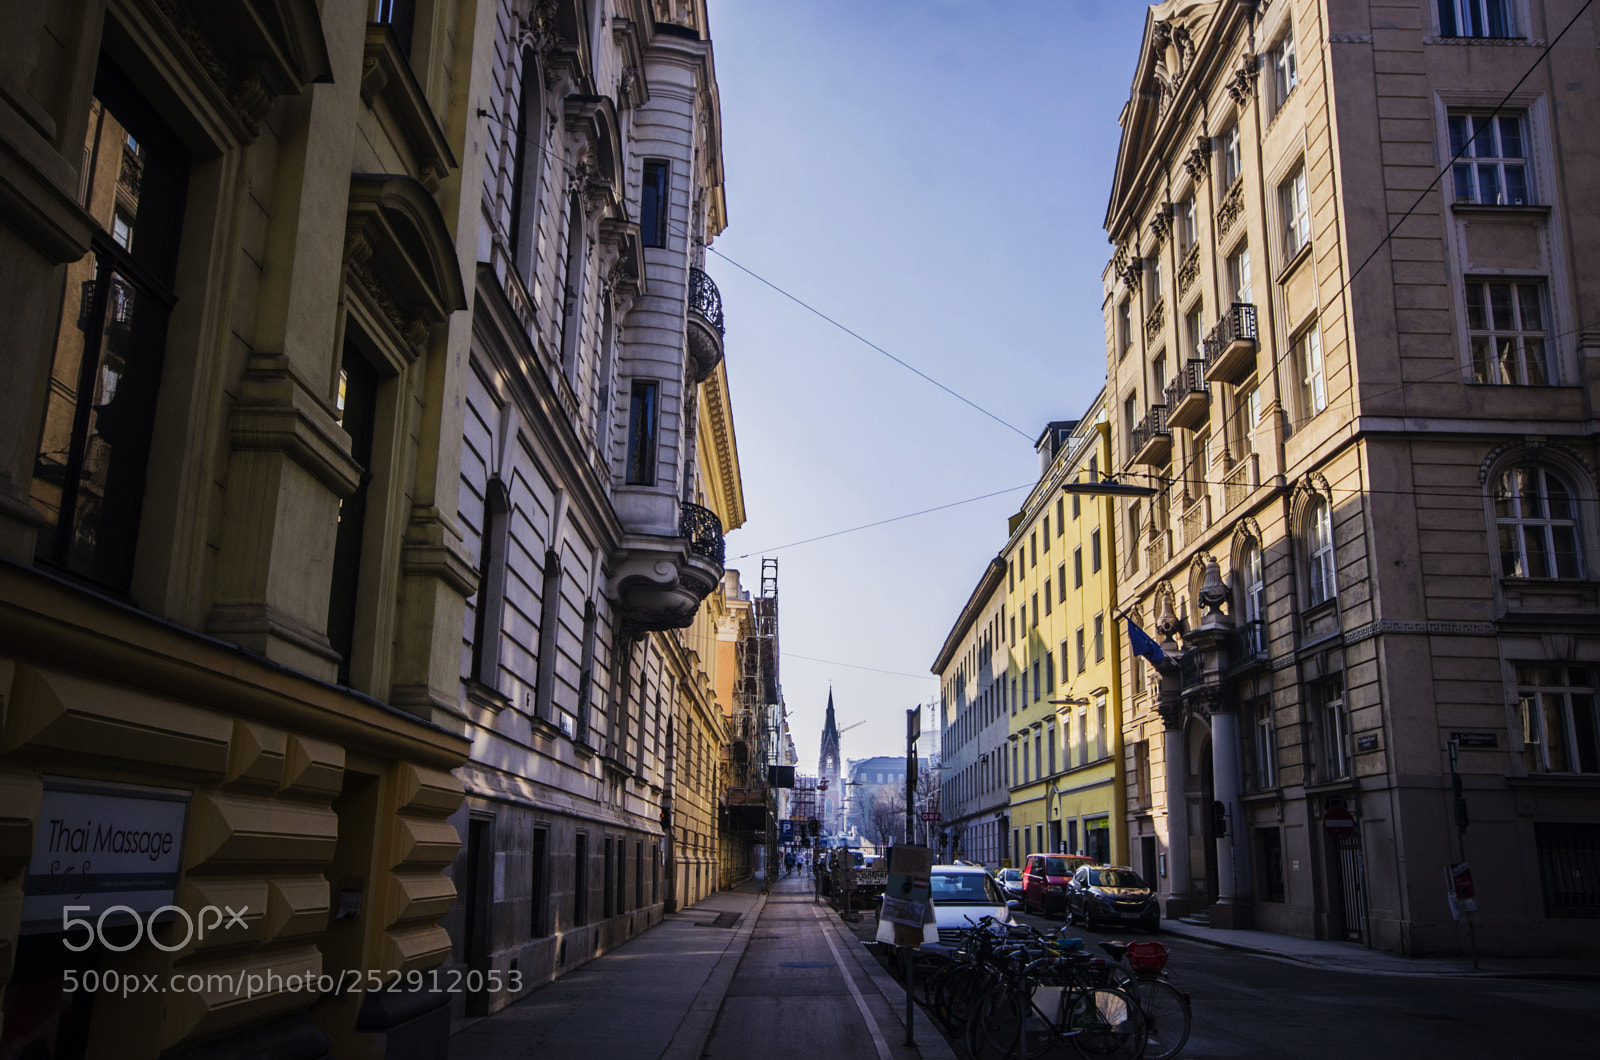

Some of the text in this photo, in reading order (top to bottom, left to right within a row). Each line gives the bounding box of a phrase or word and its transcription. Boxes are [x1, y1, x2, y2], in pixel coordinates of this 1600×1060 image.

[48, 819, 173, 861] Thai Massage
[783, 823, 791, 833] P
